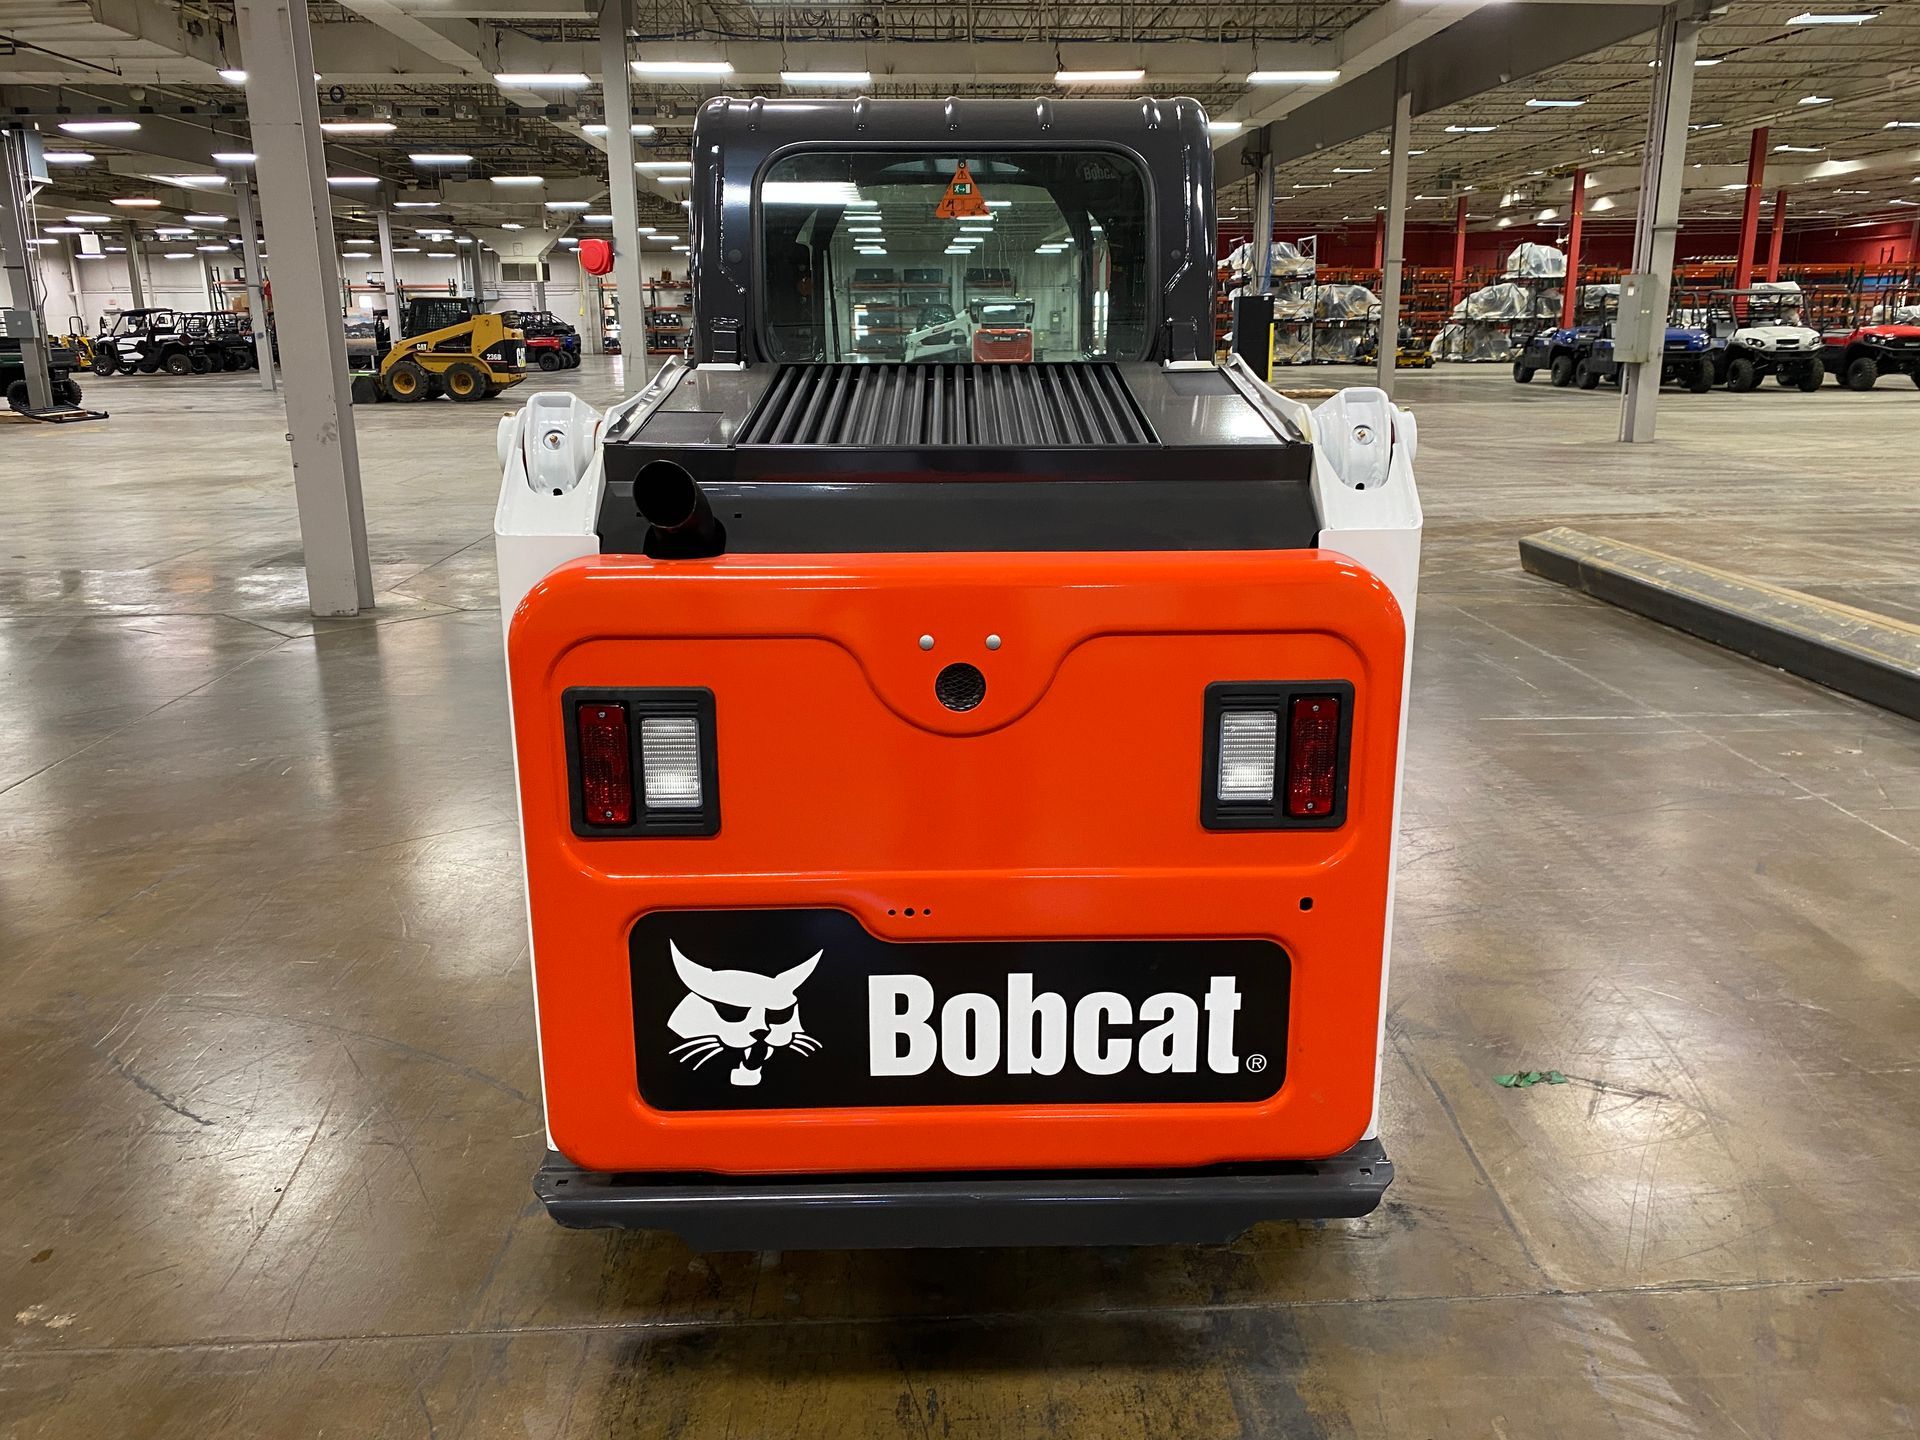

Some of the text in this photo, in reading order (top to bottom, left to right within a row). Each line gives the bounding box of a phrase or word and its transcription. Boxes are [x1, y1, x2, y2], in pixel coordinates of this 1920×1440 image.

[1083, 166, 1118, 181] Bobc
[416, 343, 427, 351] CAT
[868, 972, 1242, 1077] Bobcat
